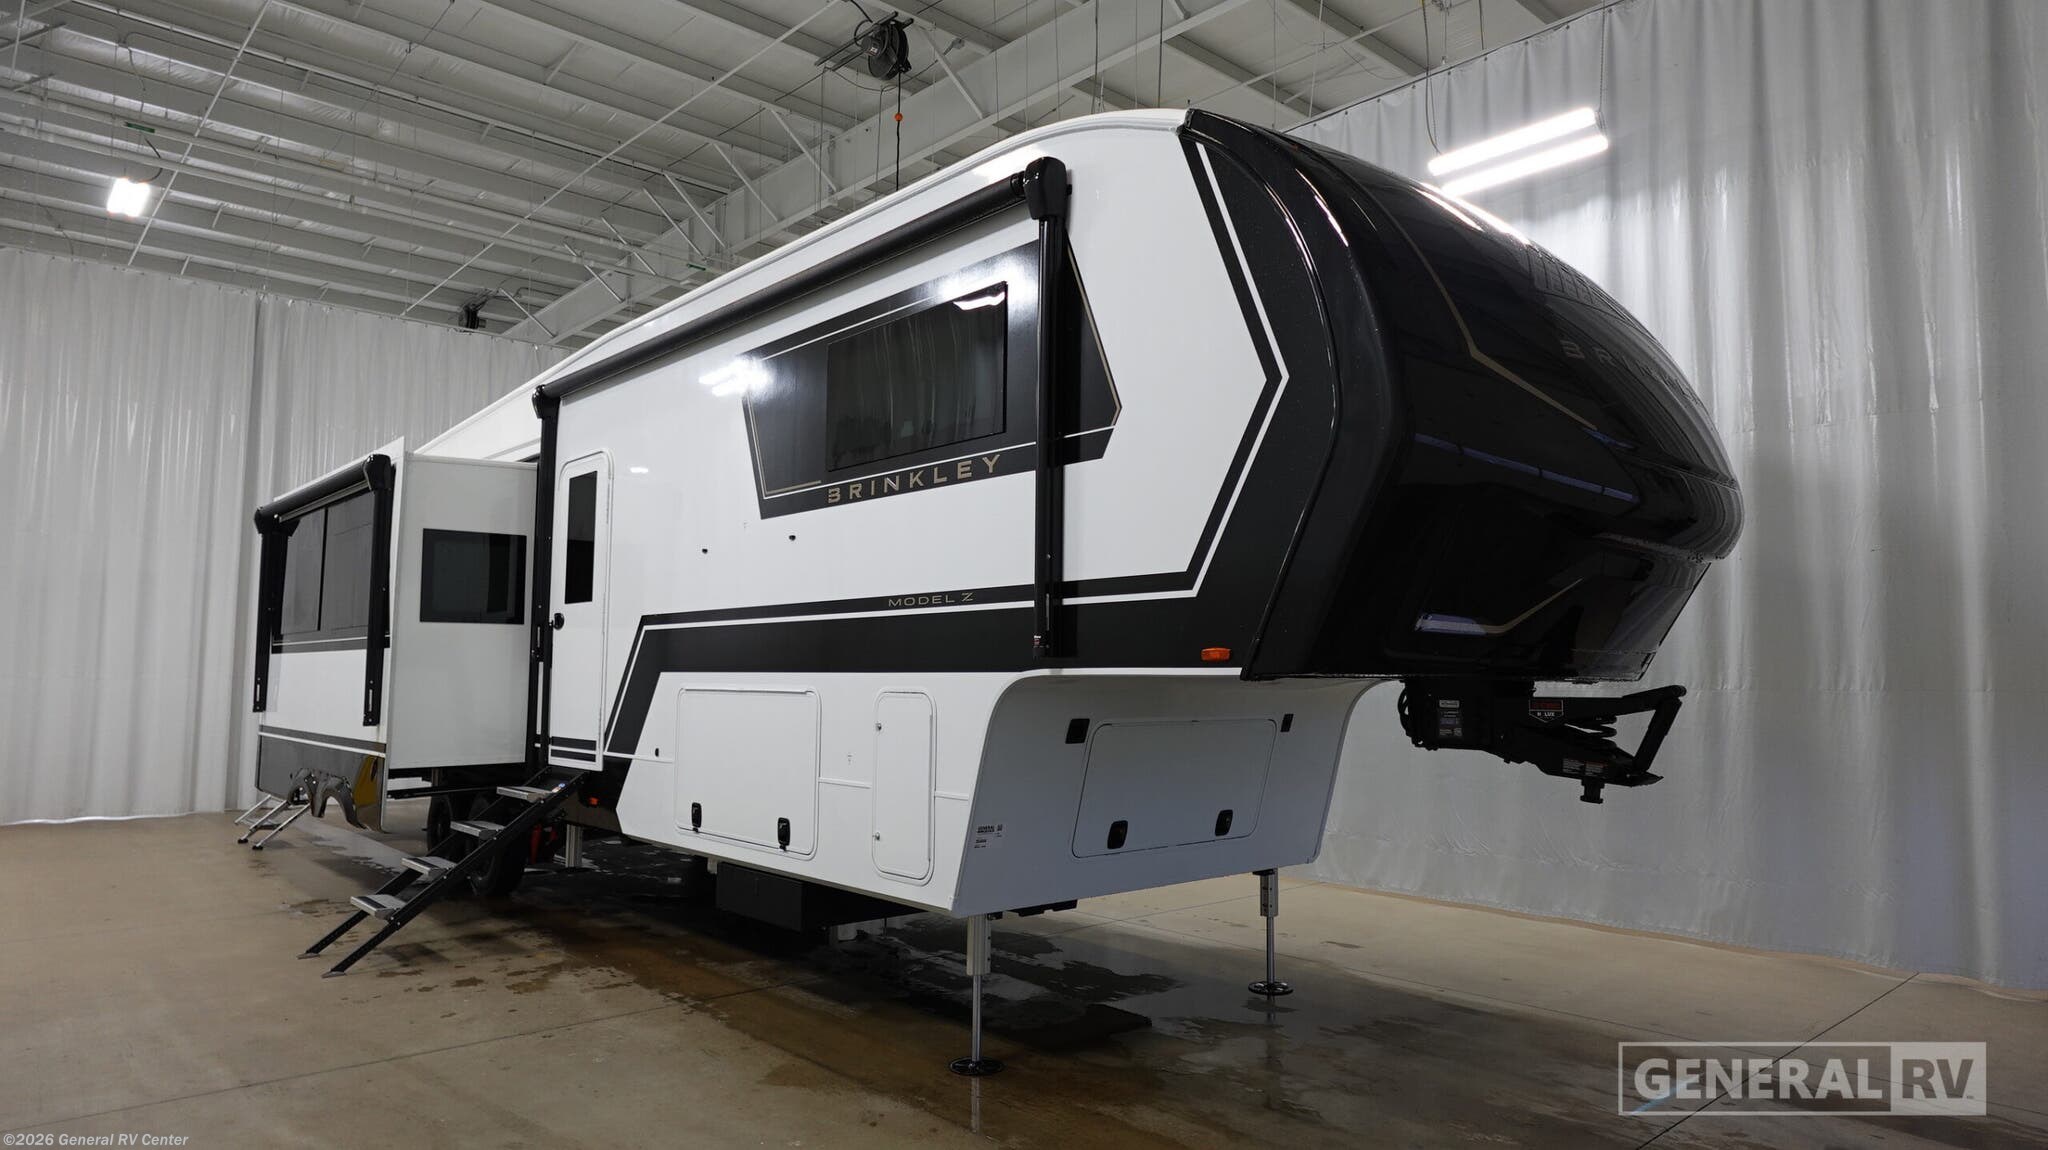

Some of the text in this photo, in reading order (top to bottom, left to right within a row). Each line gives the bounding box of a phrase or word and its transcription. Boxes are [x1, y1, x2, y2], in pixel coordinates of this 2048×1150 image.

[827, 454, 1001, 504] BRINKLEY
[887, 592, 974, 607] MODEL Z
